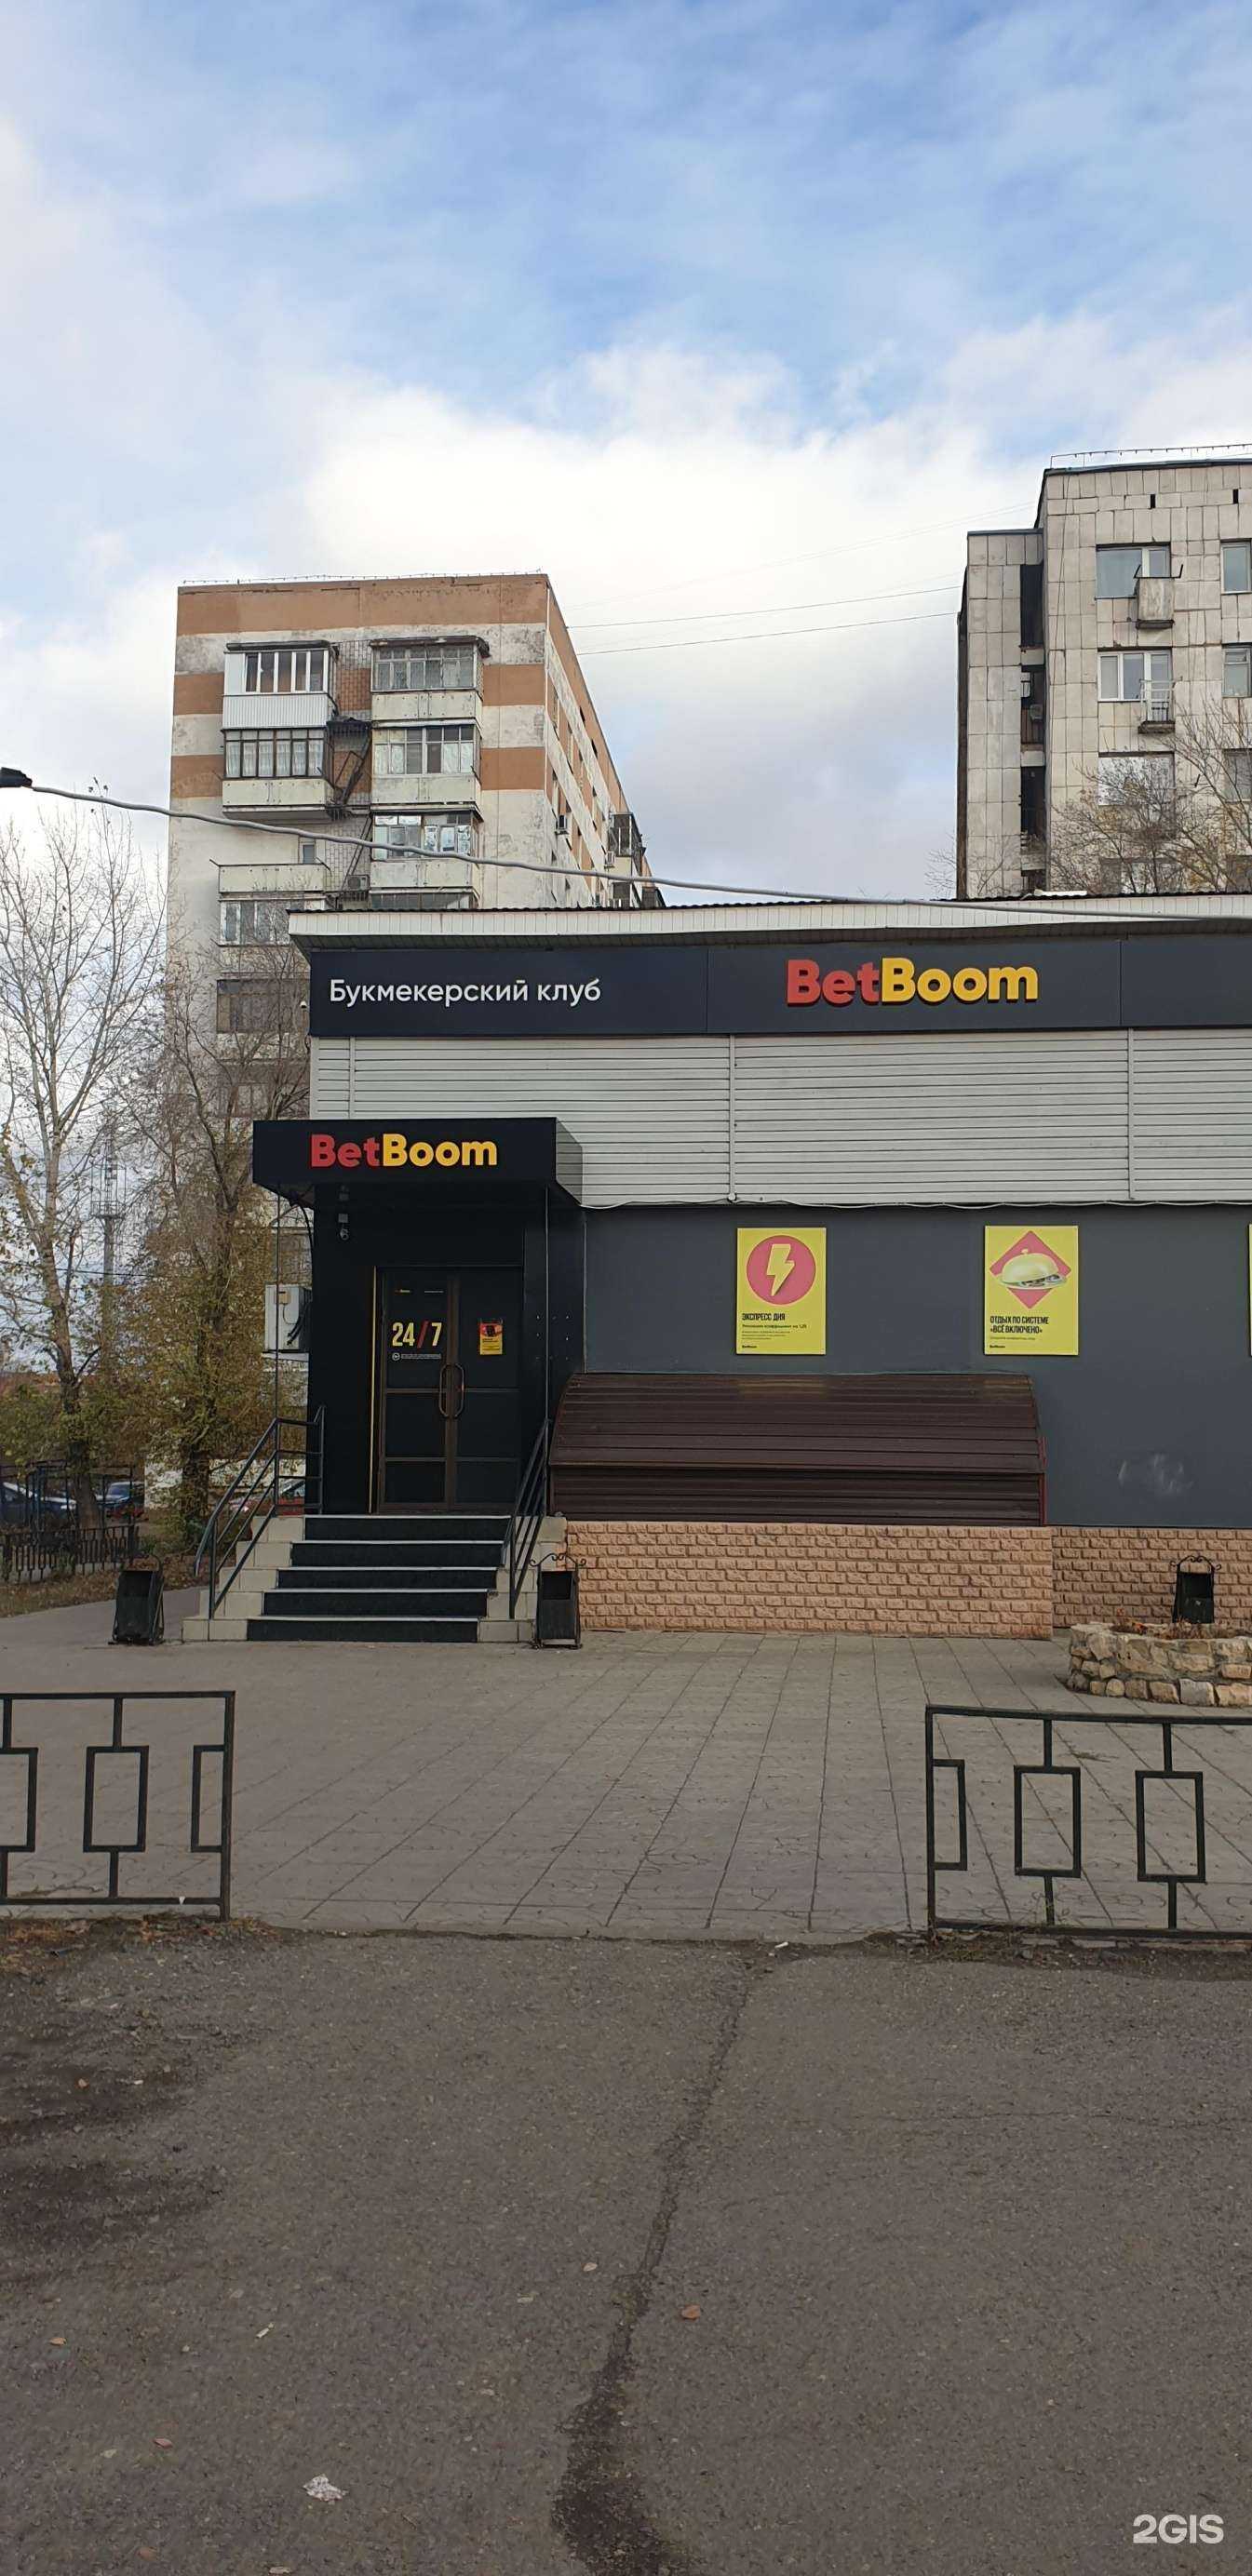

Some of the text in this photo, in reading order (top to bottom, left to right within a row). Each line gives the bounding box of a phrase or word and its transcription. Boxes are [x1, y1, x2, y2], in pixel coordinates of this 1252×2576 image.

[330, 978, 601, 1007] Букмекерский клуб
[787, 958, 1039, 1006] BetBoom
[311, 1134, 498, 1168] BetBoom
[742, 1312, 786, 1321] ЭКСПРЕСС ДНЯ
[989, 1315, 1012, 1324] ОТДЫХ
[1021, 1316, 1049, 1324] СИСТЕМЕ
[392, 1321, 442, 1348] 24/7
